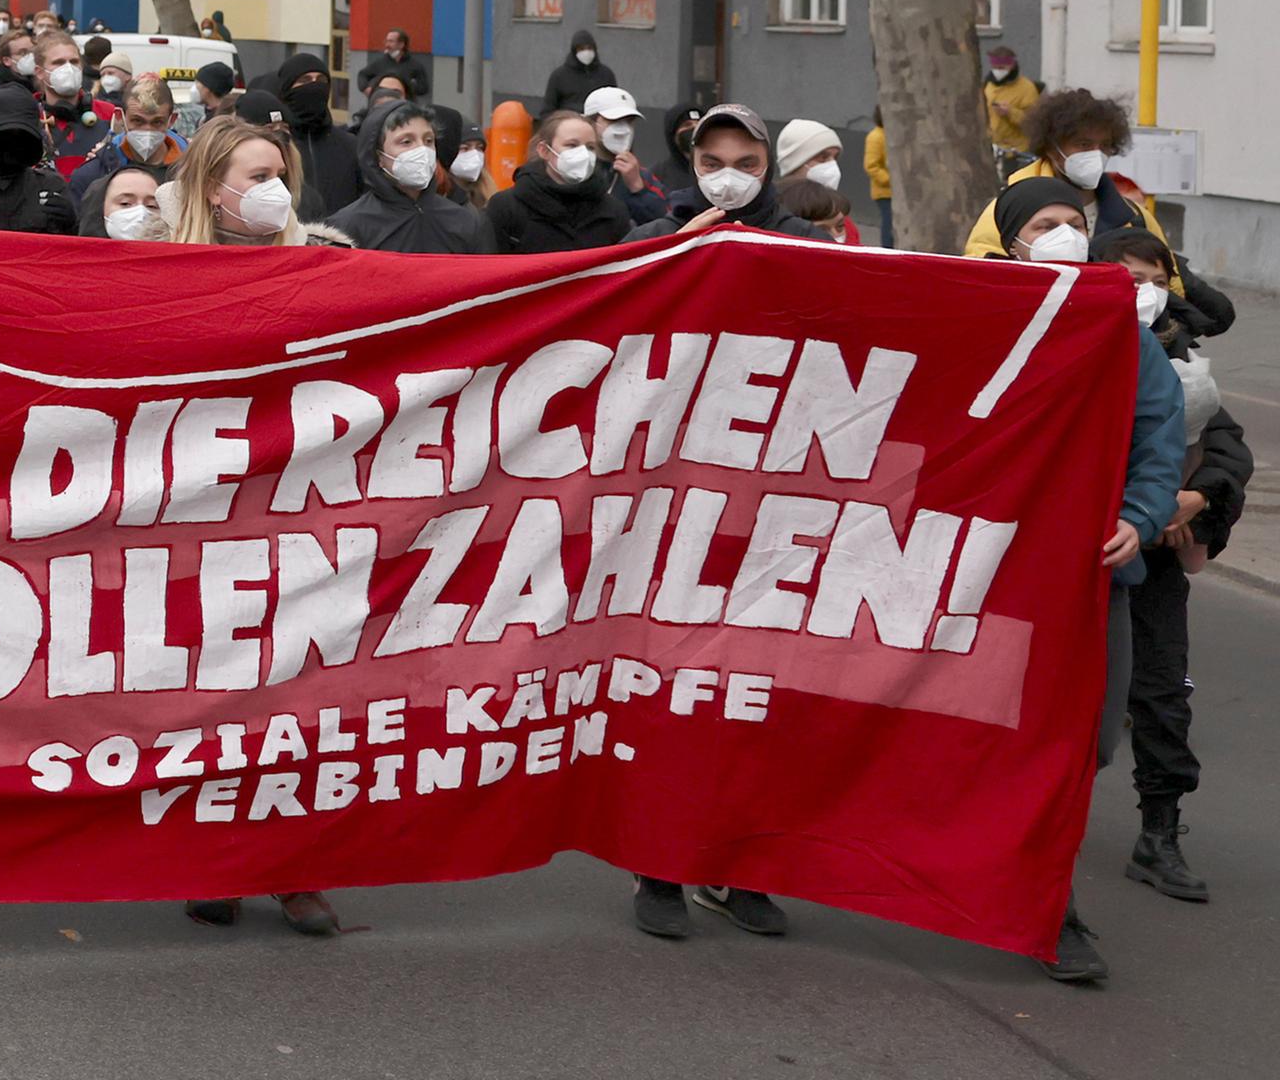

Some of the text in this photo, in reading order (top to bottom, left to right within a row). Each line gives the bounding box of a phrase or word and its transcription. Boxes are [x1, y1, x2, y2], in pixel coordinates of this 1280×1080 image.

[167, 69, 196, 79] TAXI
[9, 331, 918, 542] DIE REICHEN
[372, 486, 1019, 656] ZAHLEN!
[25, 656, 775, 795] SOZIALE KÄMPFE
[137, 710, 636, 826] VERBINDEN.
